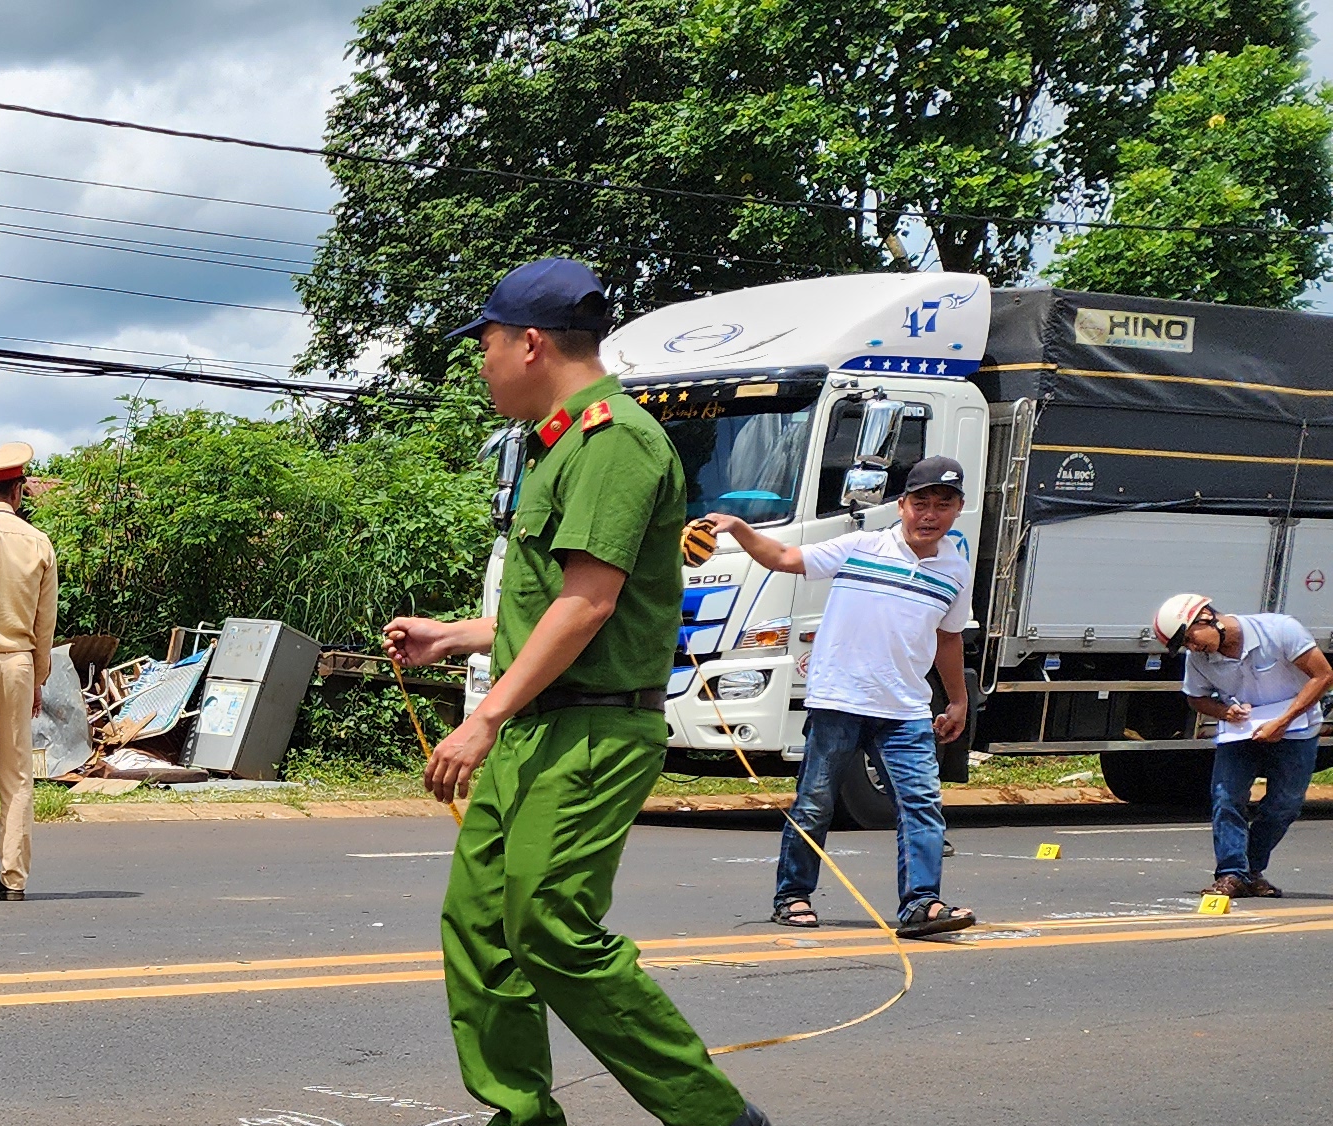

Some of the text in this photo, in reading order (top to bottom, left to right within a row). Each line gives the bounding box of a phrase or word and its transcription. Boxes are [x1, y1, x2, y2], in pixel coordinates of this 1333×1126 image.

[901, 299, 942, 338] 47
[1108, 315, 1188, 341] HINO
[688, 574, 732, 585] 500
[1043, 846, 1052, 857] 3
[1207, 897, 1219, 911] 4
